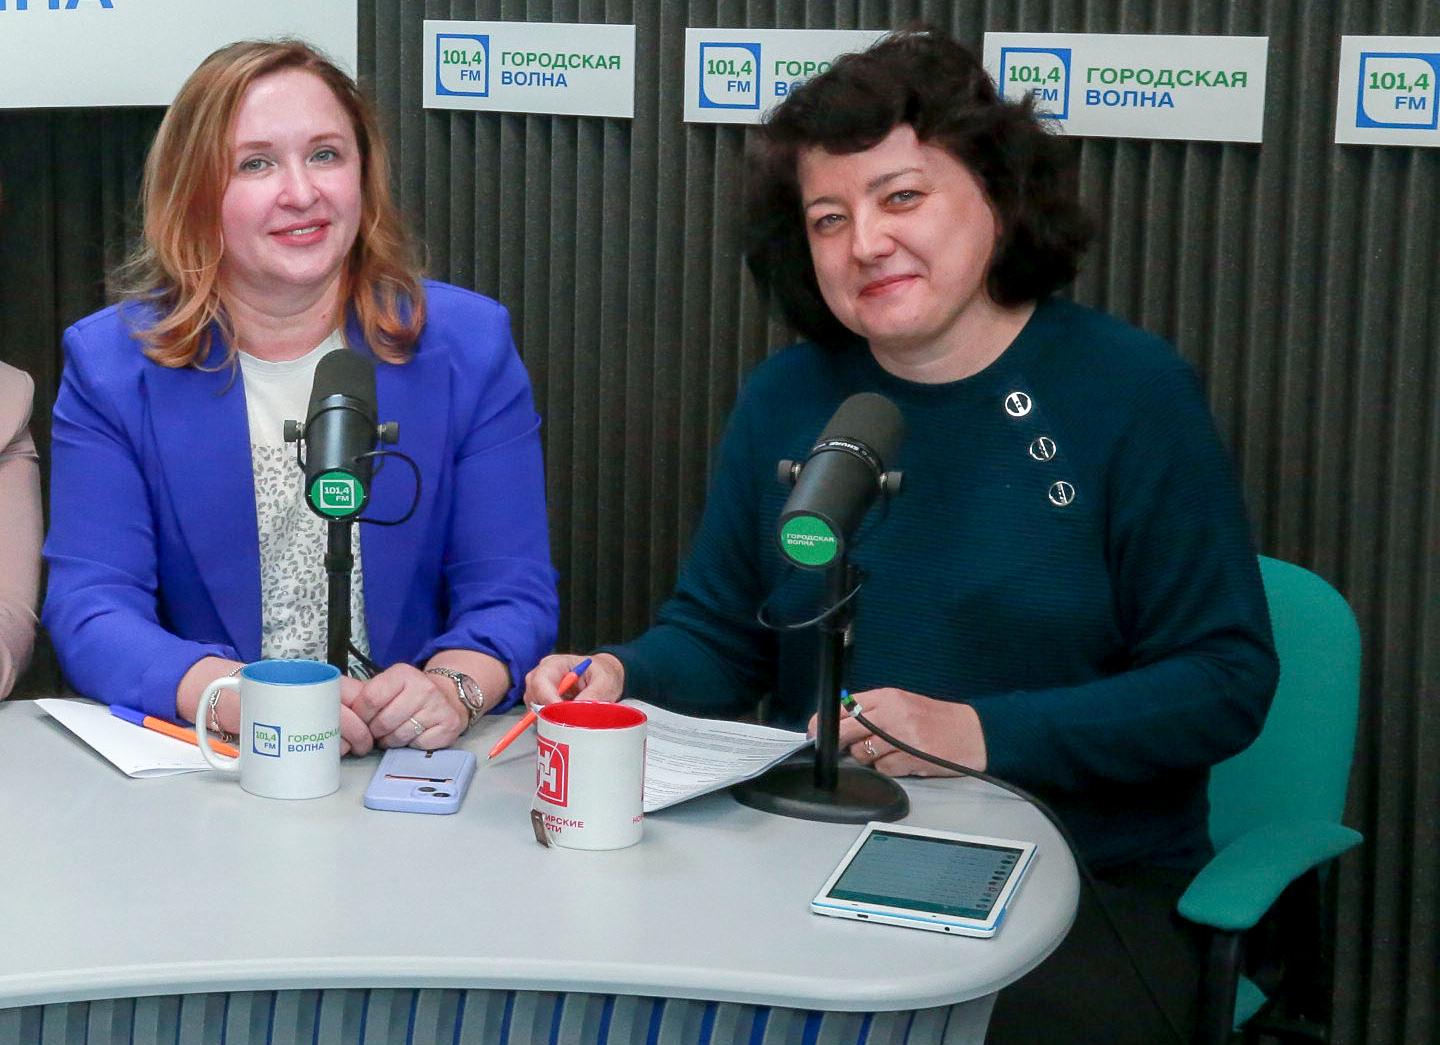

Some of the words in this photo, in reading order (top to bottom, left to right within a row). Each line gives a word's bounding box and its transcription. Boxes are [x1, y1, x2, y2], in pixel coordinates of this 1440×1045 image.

[443, 50, 482, 67] 101,4
[501, 51, 621, 70] ГОРОДСКАЯ
[460, 70, 481, 81] FM
[707, 60, 753, 77] 101,4
[1009, 65, 1061, 85] 101,4
[501, 71, 568, 87] ВОЛНА
[1087, 67, 1248, 88] ГОРОДСКАЯ
[1369, 72, 1429, 93] 101,4
[727, 80, 751, 92] FM
[1031, 88, 1058, 101] FM
[1086, 89, 1174, 108] ВОЛНА
[1395, 96, 1427, 110] FM
[324, 486, 350, 495] 101,4
[256, 731, 277, 742] 101,4
[264, 742, 277, 750] FM
[288, 742, 325, 752] ВОЛНА
